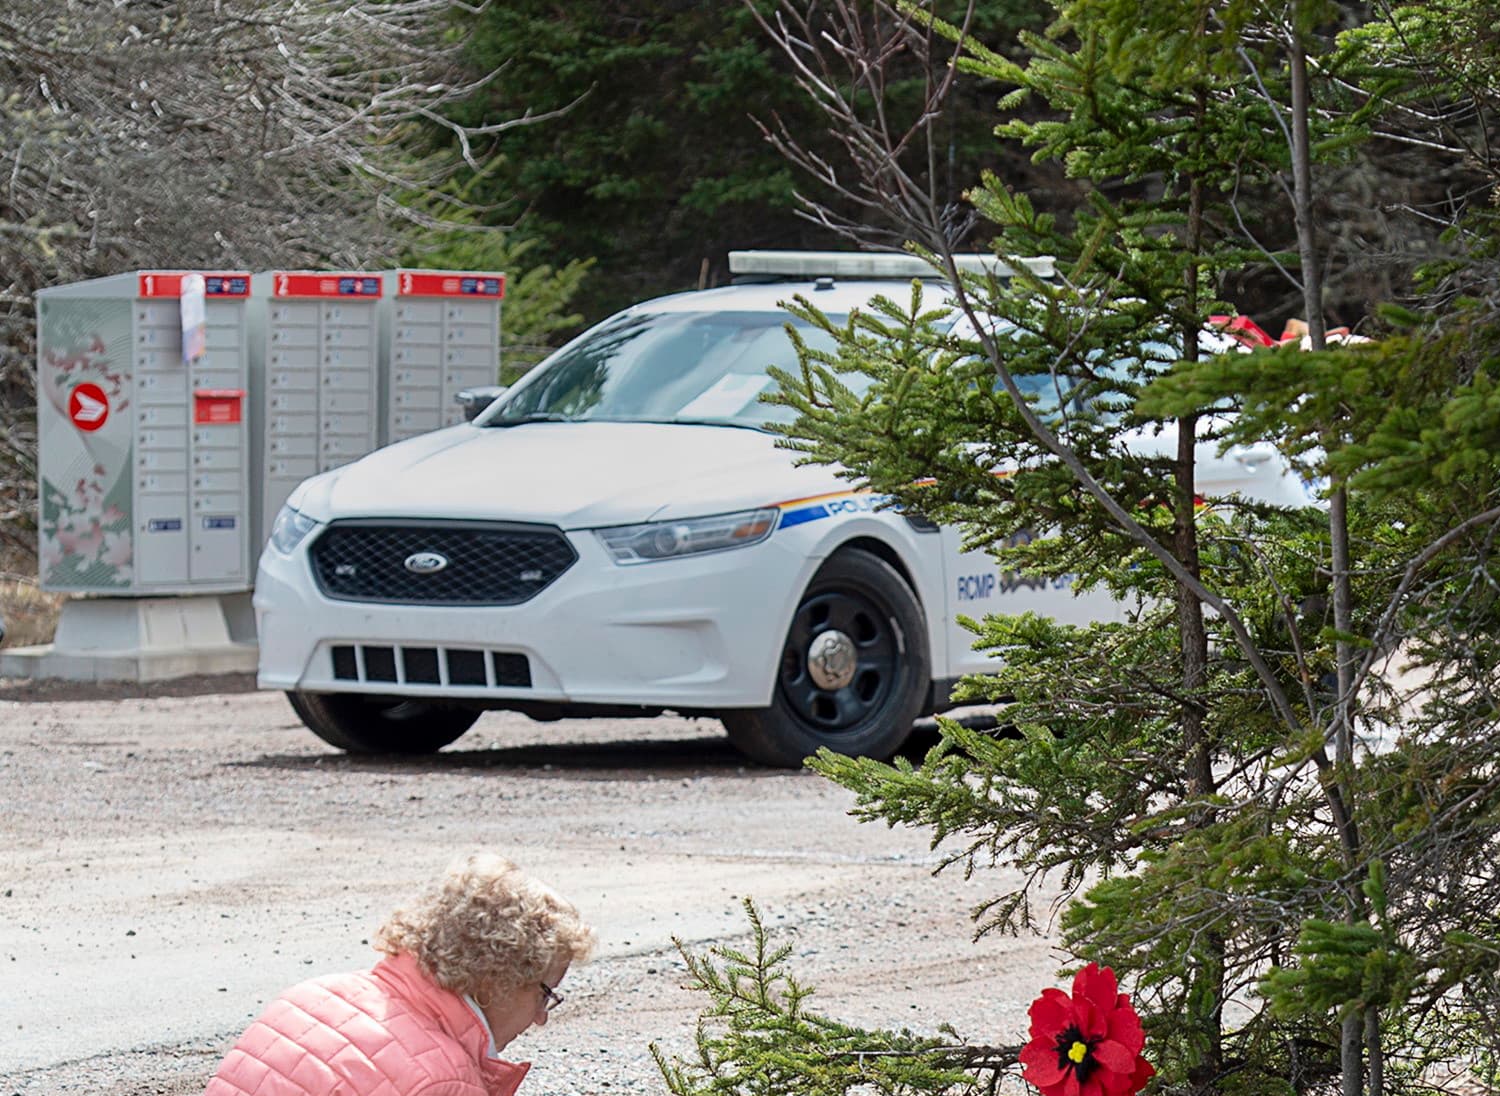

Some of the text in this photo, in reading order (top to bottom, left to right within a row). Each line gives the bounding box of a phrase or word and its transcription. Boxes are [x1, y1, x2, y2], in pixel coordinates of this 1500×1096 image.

[144, 276, 154, 297] 1
[278, 273, 289, 296] 2
[402, 273, 412, 295] 3
[827, 494, 906, 515] POLIC
[958, 574, 994, 600] RCMP
